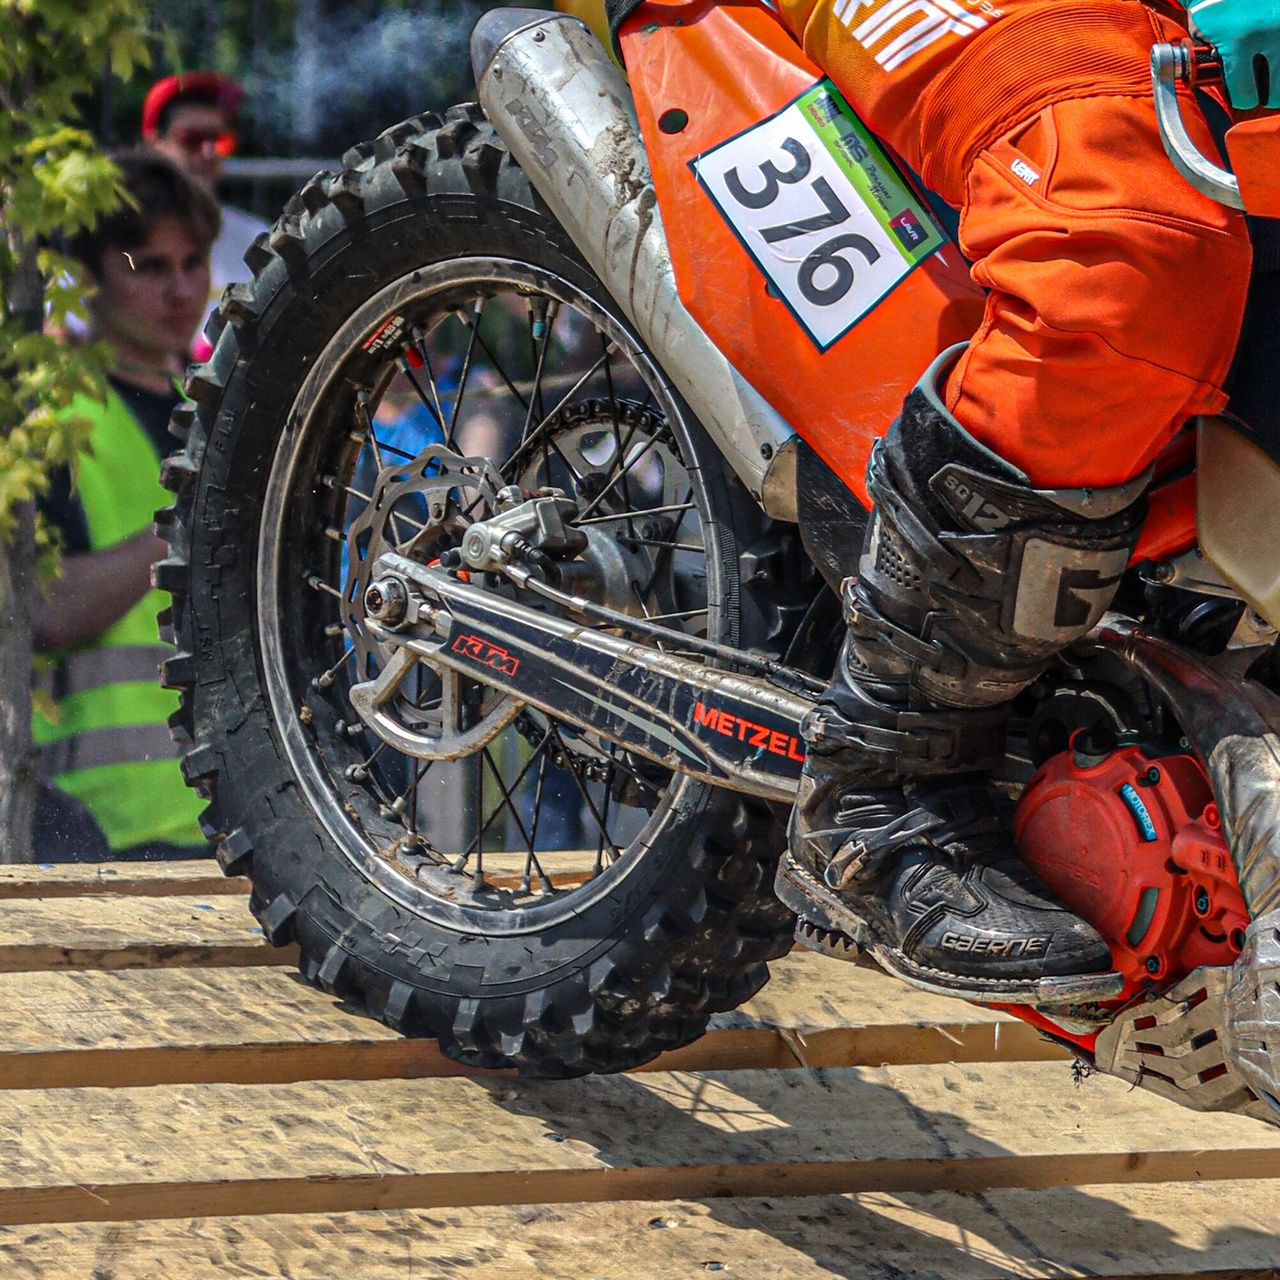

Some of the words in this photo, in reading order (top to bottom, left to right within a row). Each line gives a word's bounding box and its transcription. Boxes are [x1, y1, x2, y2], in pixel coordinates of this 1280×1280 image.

[722, 135, 882, 306] 376
[900, 217, 919, 241] LAVR
[451, 634, 519, 677] KTM
[692, 701, 806, 764] METZEL
[1124, 786, 1155, 834] MOTOREX
